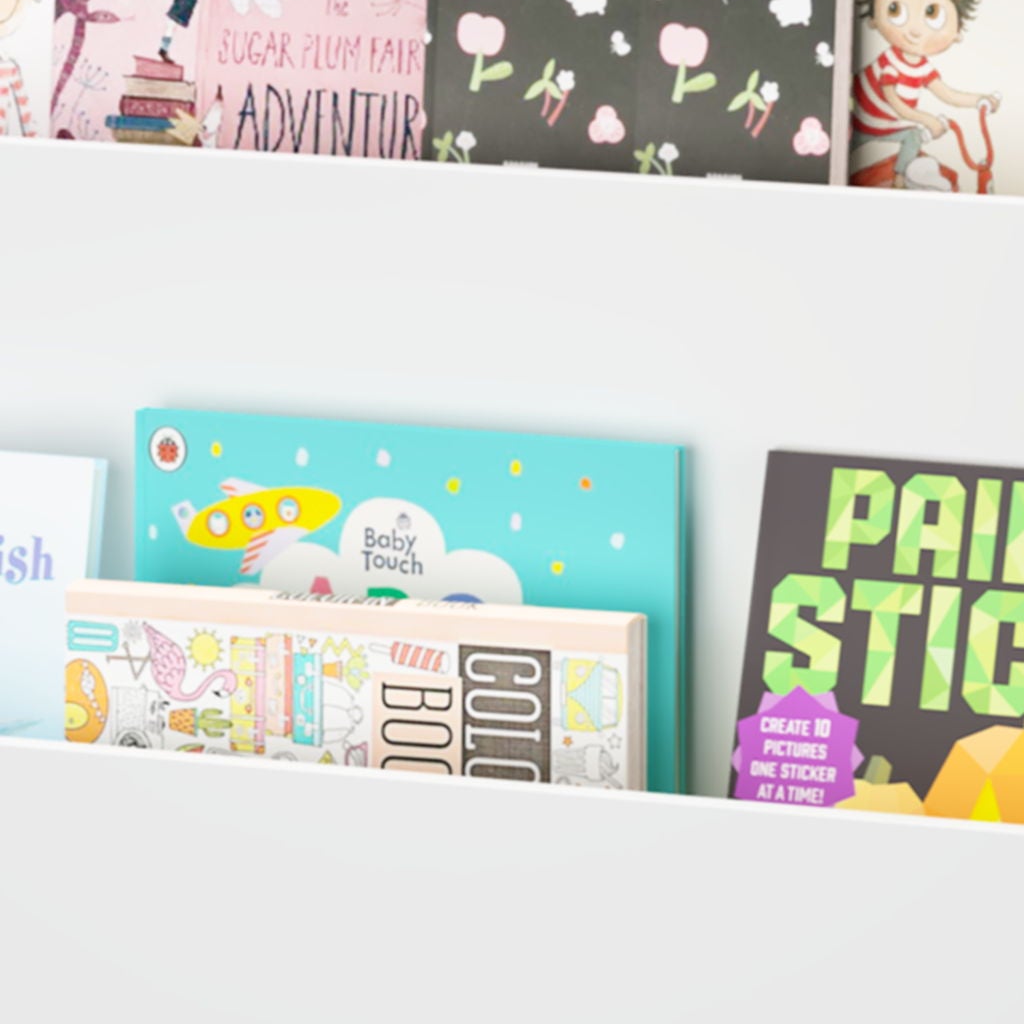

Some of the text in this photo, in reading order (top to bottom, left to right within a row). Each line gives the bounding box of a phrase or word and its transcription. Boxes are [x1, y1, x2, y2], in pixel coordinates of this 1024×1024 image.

[217, 29, 296, 69] SUGAR
[300, 33, 361, 72] PLUM
[364, 527, 417, 556] Baby
[361, 550, 424, 575] Touch
[760, 716, 832, 738] CREATE 10
[762, 738, 828, 760] PICTURES
[749, 760, 837, 784] ONE STICKER
[757, 783, 825, 805] AT A TIME!
